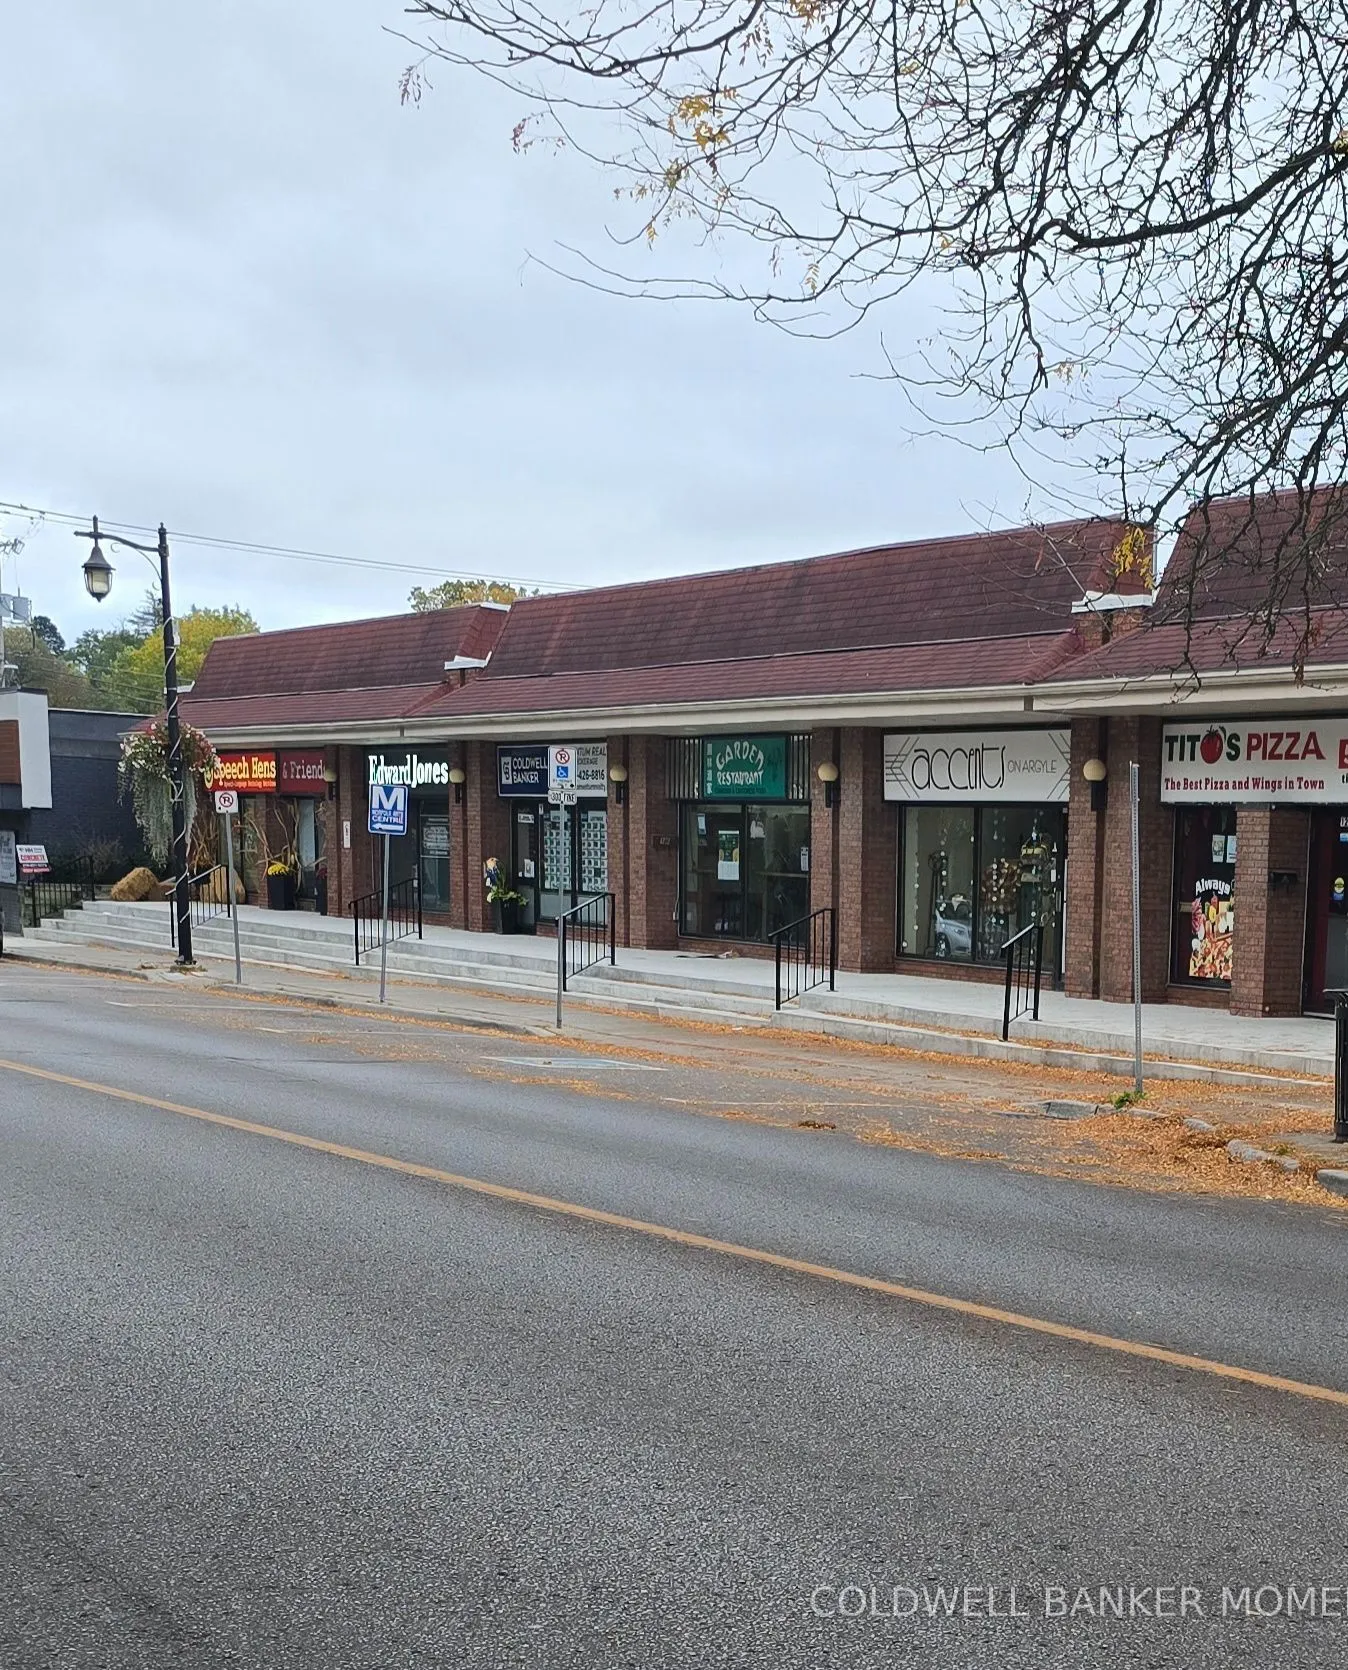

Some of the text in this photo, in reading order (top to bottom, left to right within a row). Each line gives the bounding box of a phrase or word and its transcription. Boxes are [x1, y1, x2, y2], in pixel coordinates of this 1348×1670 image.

[716, 741, 765, 770] GARDEN
[1246, 731, 1327, 761] PIZZA
[214, 756, 277, 785] Speech Hens
[290, 760, 327, 780] Friend
[368, 754, 449, 788] Edward Jones
[513, 757, 548, 769] COLDWELL
[911, 743, 1006, 790] accents
[1023, 759, 1057, 774] ARGYLE
[513, 771, 540, 783] BANKER
[717, 770, 764, 785] RESTAURANT
[1164, 776, 1325, 792] The Best Pizza and Wings in Town
[371, 786, 405, 811] M
[1195, 878, 1231, 896] Always
